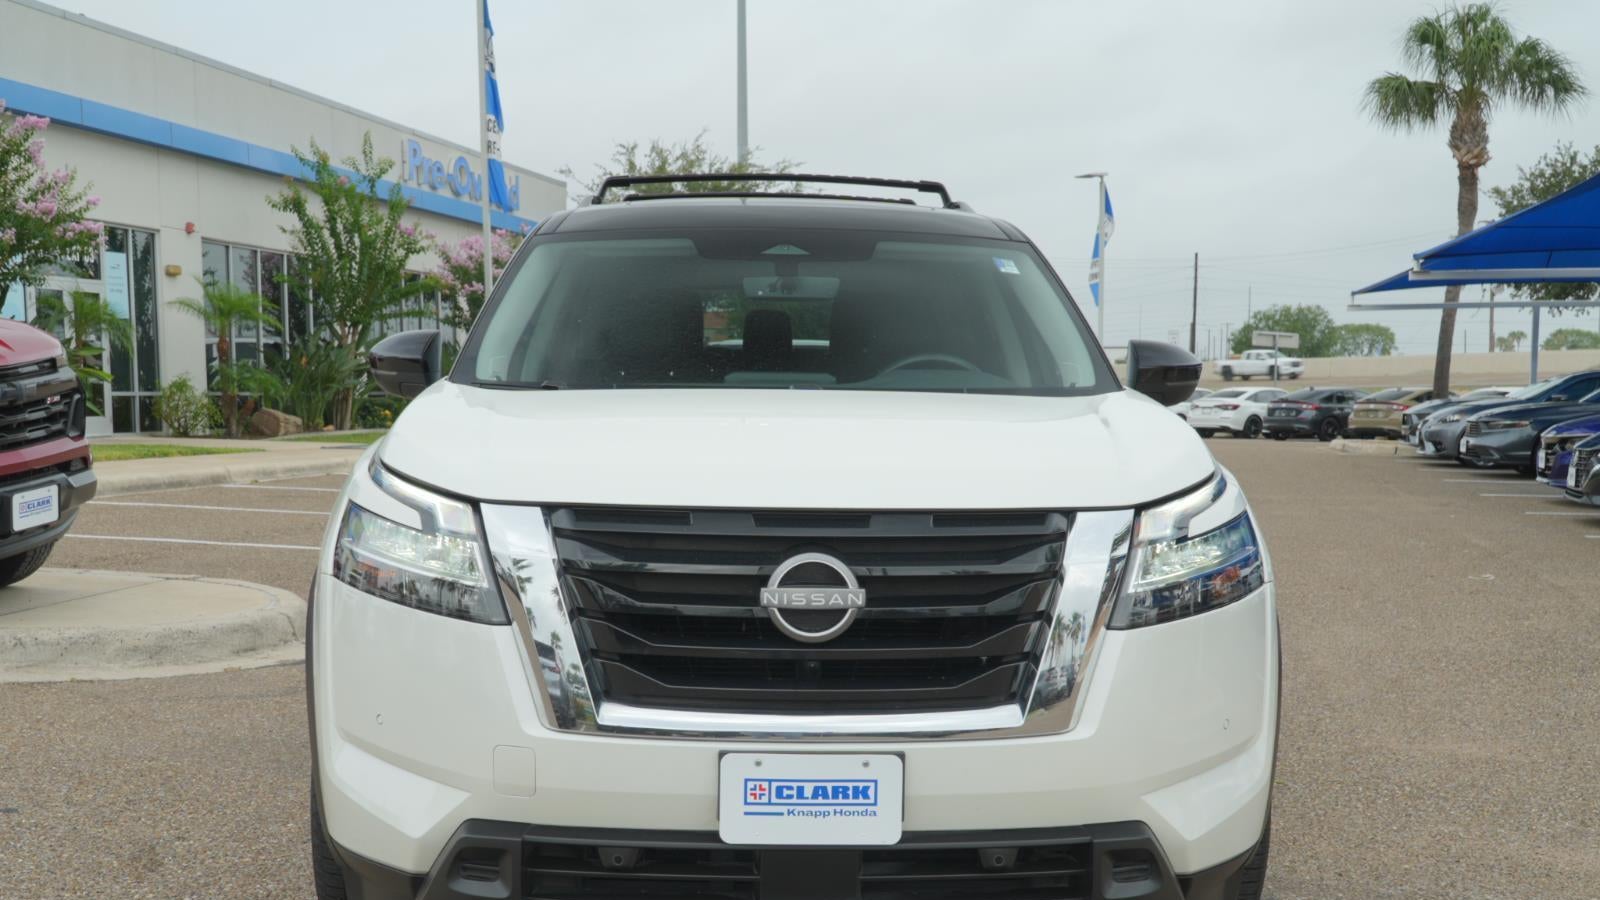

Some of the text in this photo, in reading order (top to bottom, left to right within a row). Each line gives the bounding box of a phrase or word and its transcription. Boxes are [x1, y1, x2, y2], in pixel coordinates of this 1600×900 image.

[27, 499, 50, 510] CLARK
[763, 592, 863, 605] NISSAN
[775, 785, 872, 800] CLARK
[787, 808, 877, 819] Knapp Honda
